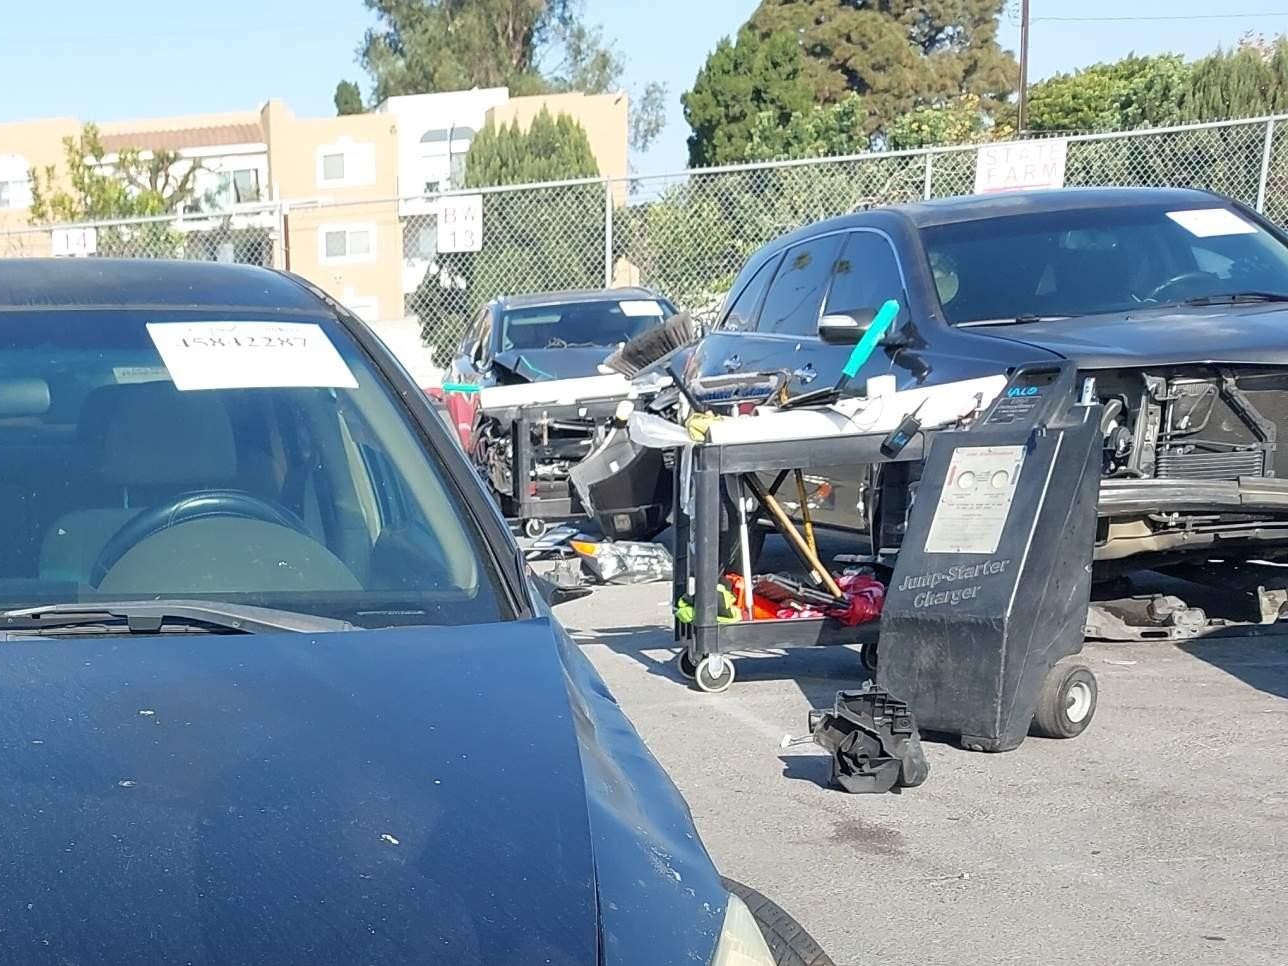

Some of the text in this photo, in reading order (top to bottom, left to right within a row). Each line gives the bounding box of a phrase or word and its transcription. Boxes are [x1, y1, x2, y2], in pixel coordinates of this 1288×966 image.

[984, 143, 1063, 165] STATE
[987, 162, 1057, 184] FARM
[450, 229, 474, 248] 13
[898, 559, 1010, 591] Jump-Starter
[913, 585, 982, 608] Charger
